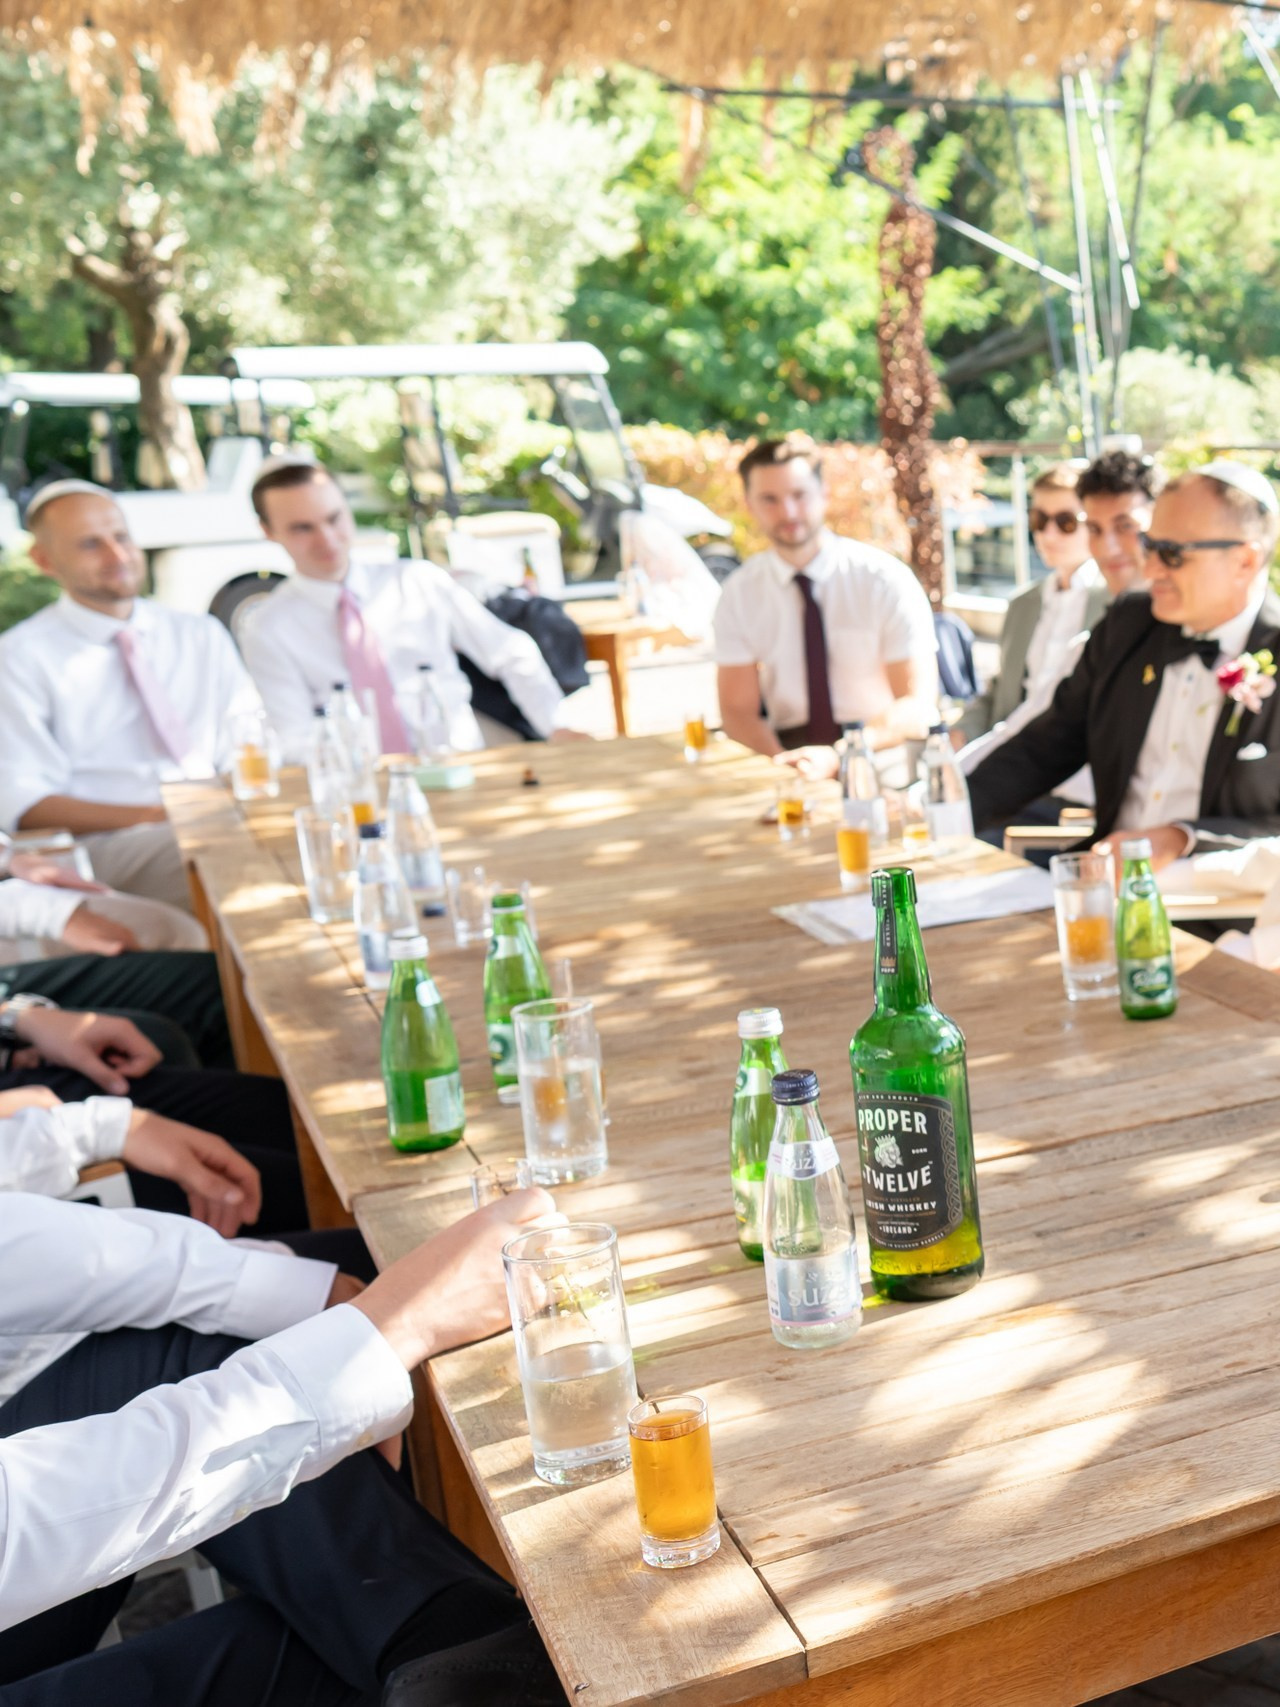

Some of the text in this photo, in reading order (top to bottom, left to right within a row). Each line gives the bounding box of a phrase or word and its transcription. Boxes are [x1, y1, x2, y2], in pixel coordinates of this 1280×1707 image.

[858, 1108, 928, 1135] PROPER
[863, 1163, 932, 1193] TWELVE
[888, 1200, 937, 1212] WHISKEY
[882, 1225, 912, 1235] IRELAND
